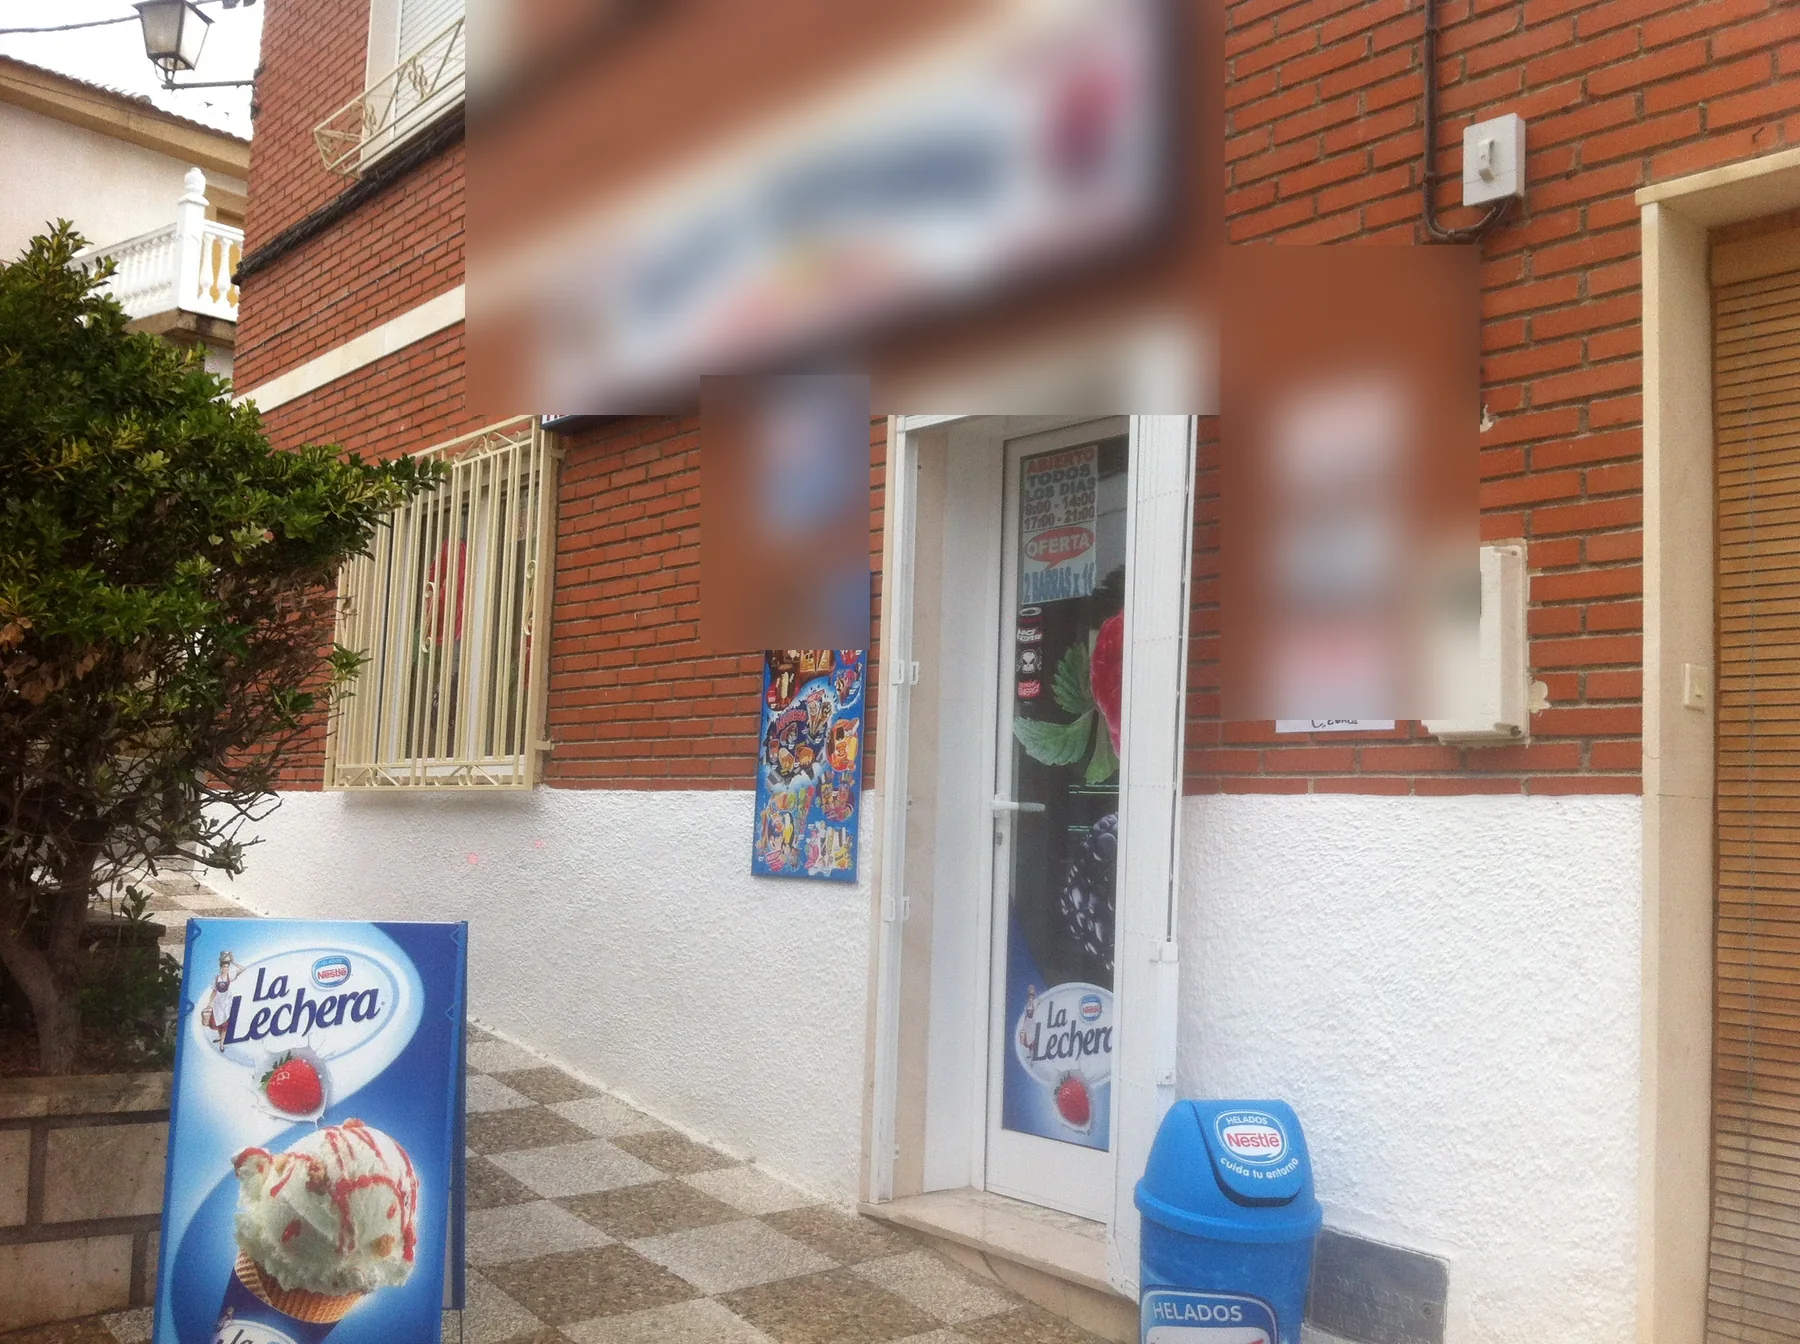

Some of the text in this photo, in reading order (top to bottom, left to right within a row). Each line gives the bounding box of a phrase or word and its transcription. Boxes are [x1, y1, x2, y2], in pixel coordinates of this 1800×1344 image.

[1027, 464, 1091, 487] TODOS
[1025, 477, 1096, 502] LOS DIAS
[1062, 491, 1095, 510] 14:00
[1024, 513, 1055, 529] 17:00
[1064, 505, 1095, 523] 21:00
[1026, 532, 1089, 556] OFERTA
[252, 968, 290, 1002] La
[224, 988, 382, 1045] Lechera
[1047, 1001, 1068, 1028] La
[1226, 1115, 1268, 1125] HELADOS
[1221, 1158, 1299, 1179] cuida tu entorno
[1153, 1302, 1243, 1322] HELADOS
